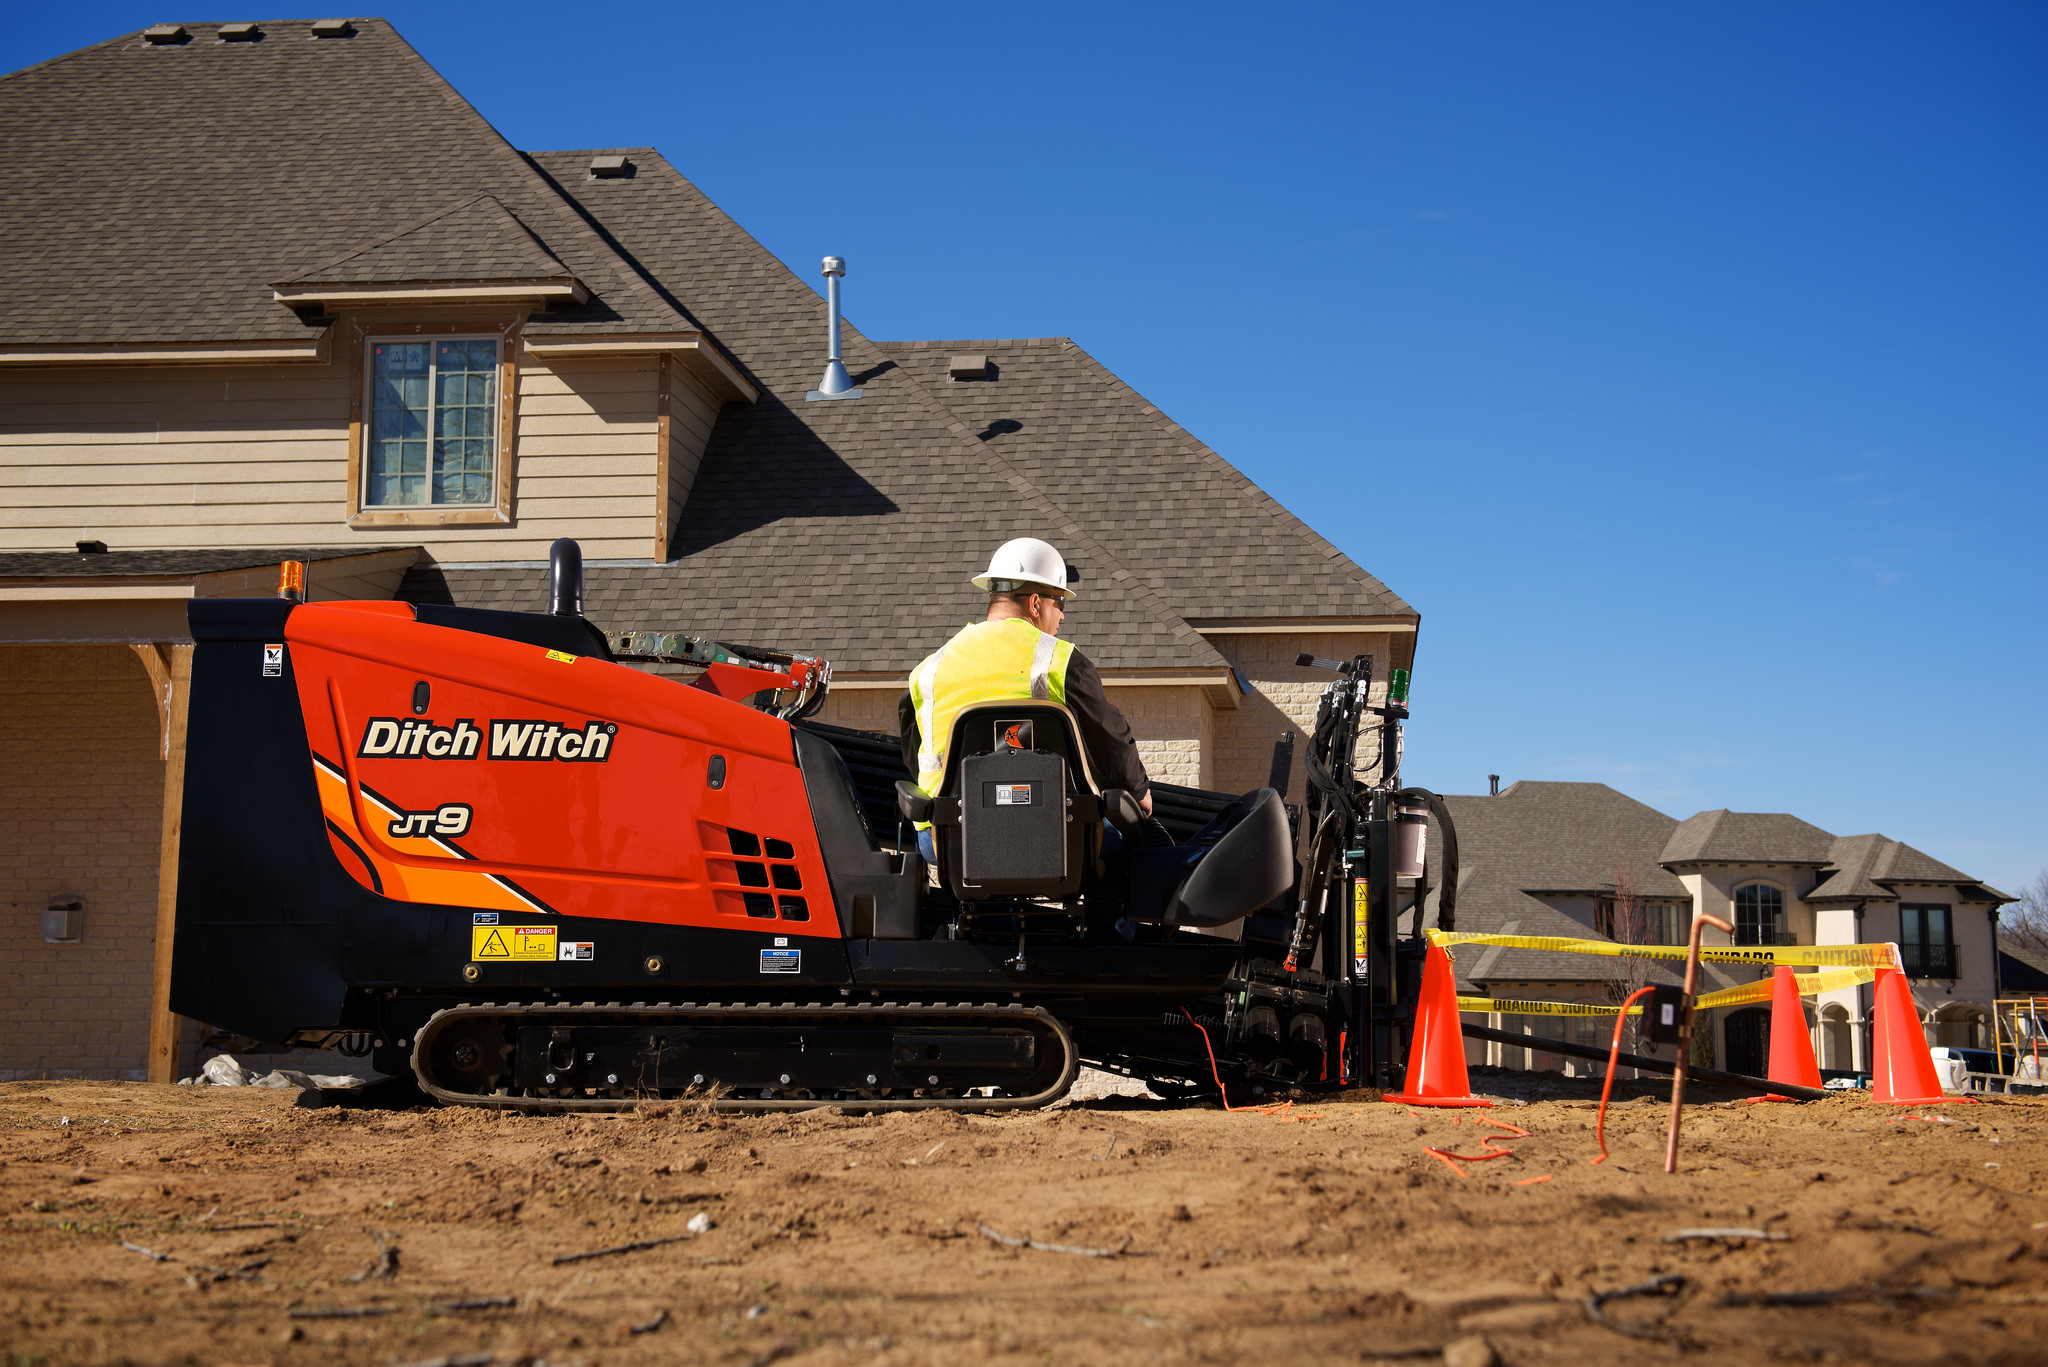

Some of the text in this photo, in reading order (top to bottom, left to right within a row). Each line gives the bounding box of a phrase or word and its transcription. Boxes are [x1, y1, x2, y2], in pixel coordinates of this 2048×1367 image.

[363, 721, 479, 756] Ditch
[392, 807, 470, 834] JT9
[1802, 949, 1874, 967] CAUTION
